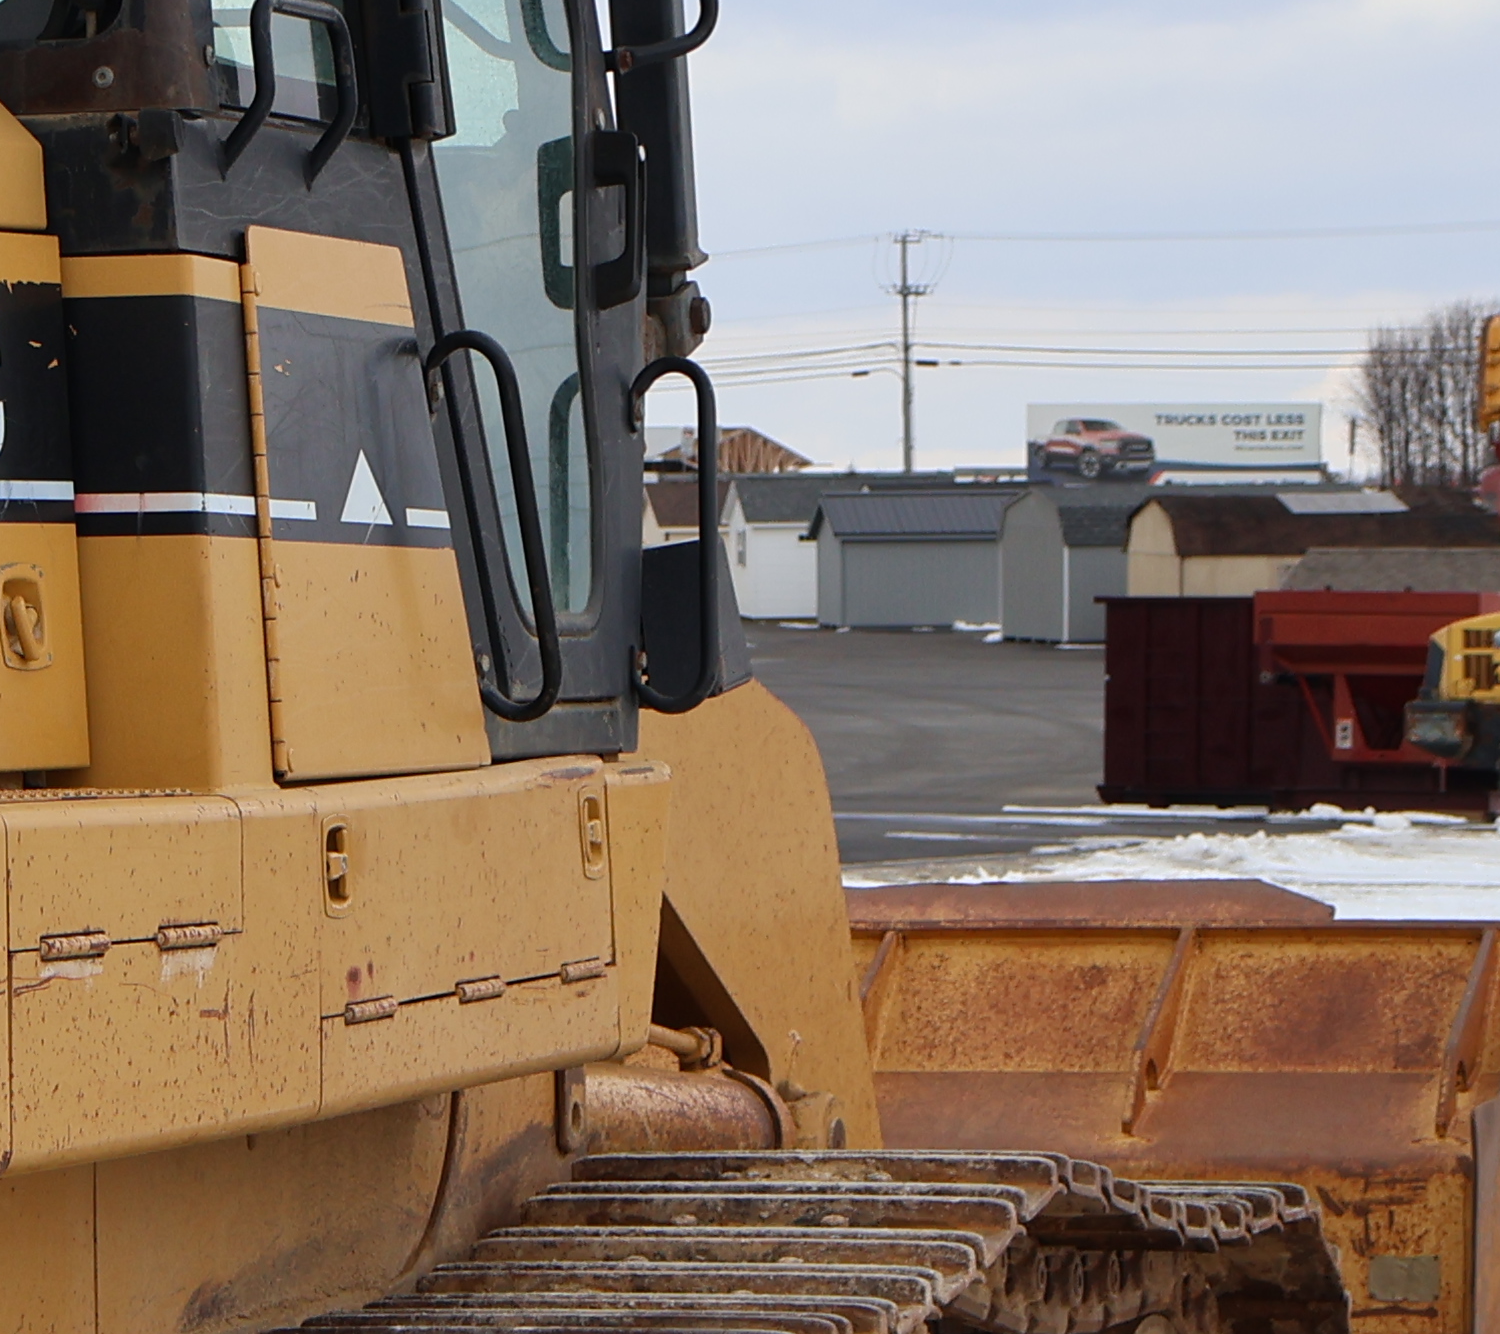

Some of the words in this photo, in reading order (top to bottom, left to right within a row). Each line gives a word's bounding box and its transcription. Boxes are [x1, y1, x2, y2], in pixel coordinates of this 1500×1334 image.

[1155, 414, 1217, 426] TRUCKS
[1221, 414, 1262, 426] COST
[1267, 414, 1305, 426] LESS
[1234, 429, 1267, 441] THIS
[1271, 429, 1305, 441] EXIT
